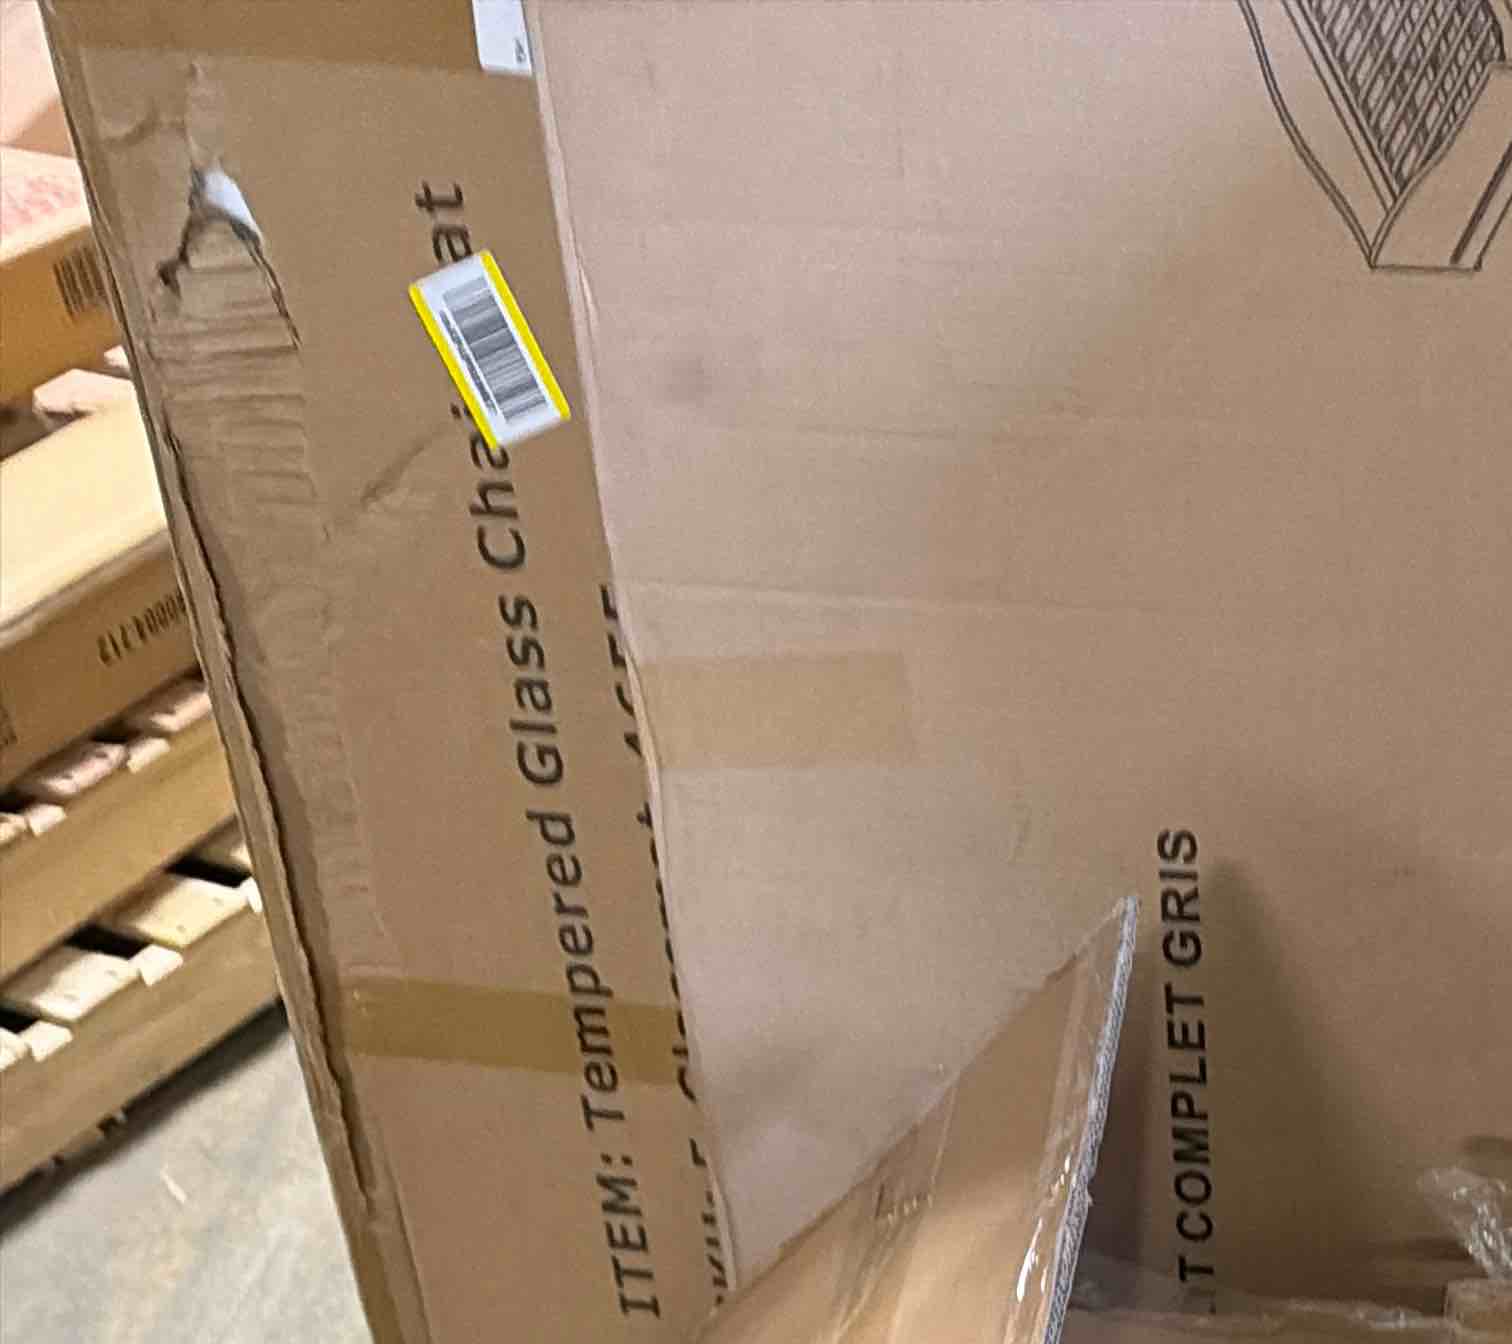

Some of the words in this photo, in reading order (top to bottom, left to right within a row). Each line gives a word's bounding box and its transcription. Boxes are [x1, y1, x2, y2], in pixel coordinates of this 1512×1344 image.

[500, 593, 564, 787] Glass
[525, 807, 625, 1133] Tempered
[1158, 828, 1202, 968] GRIS
[1163, 982, 1214, 1243] COMPLET
[595, 1151, 661, 1320] ITEM:
